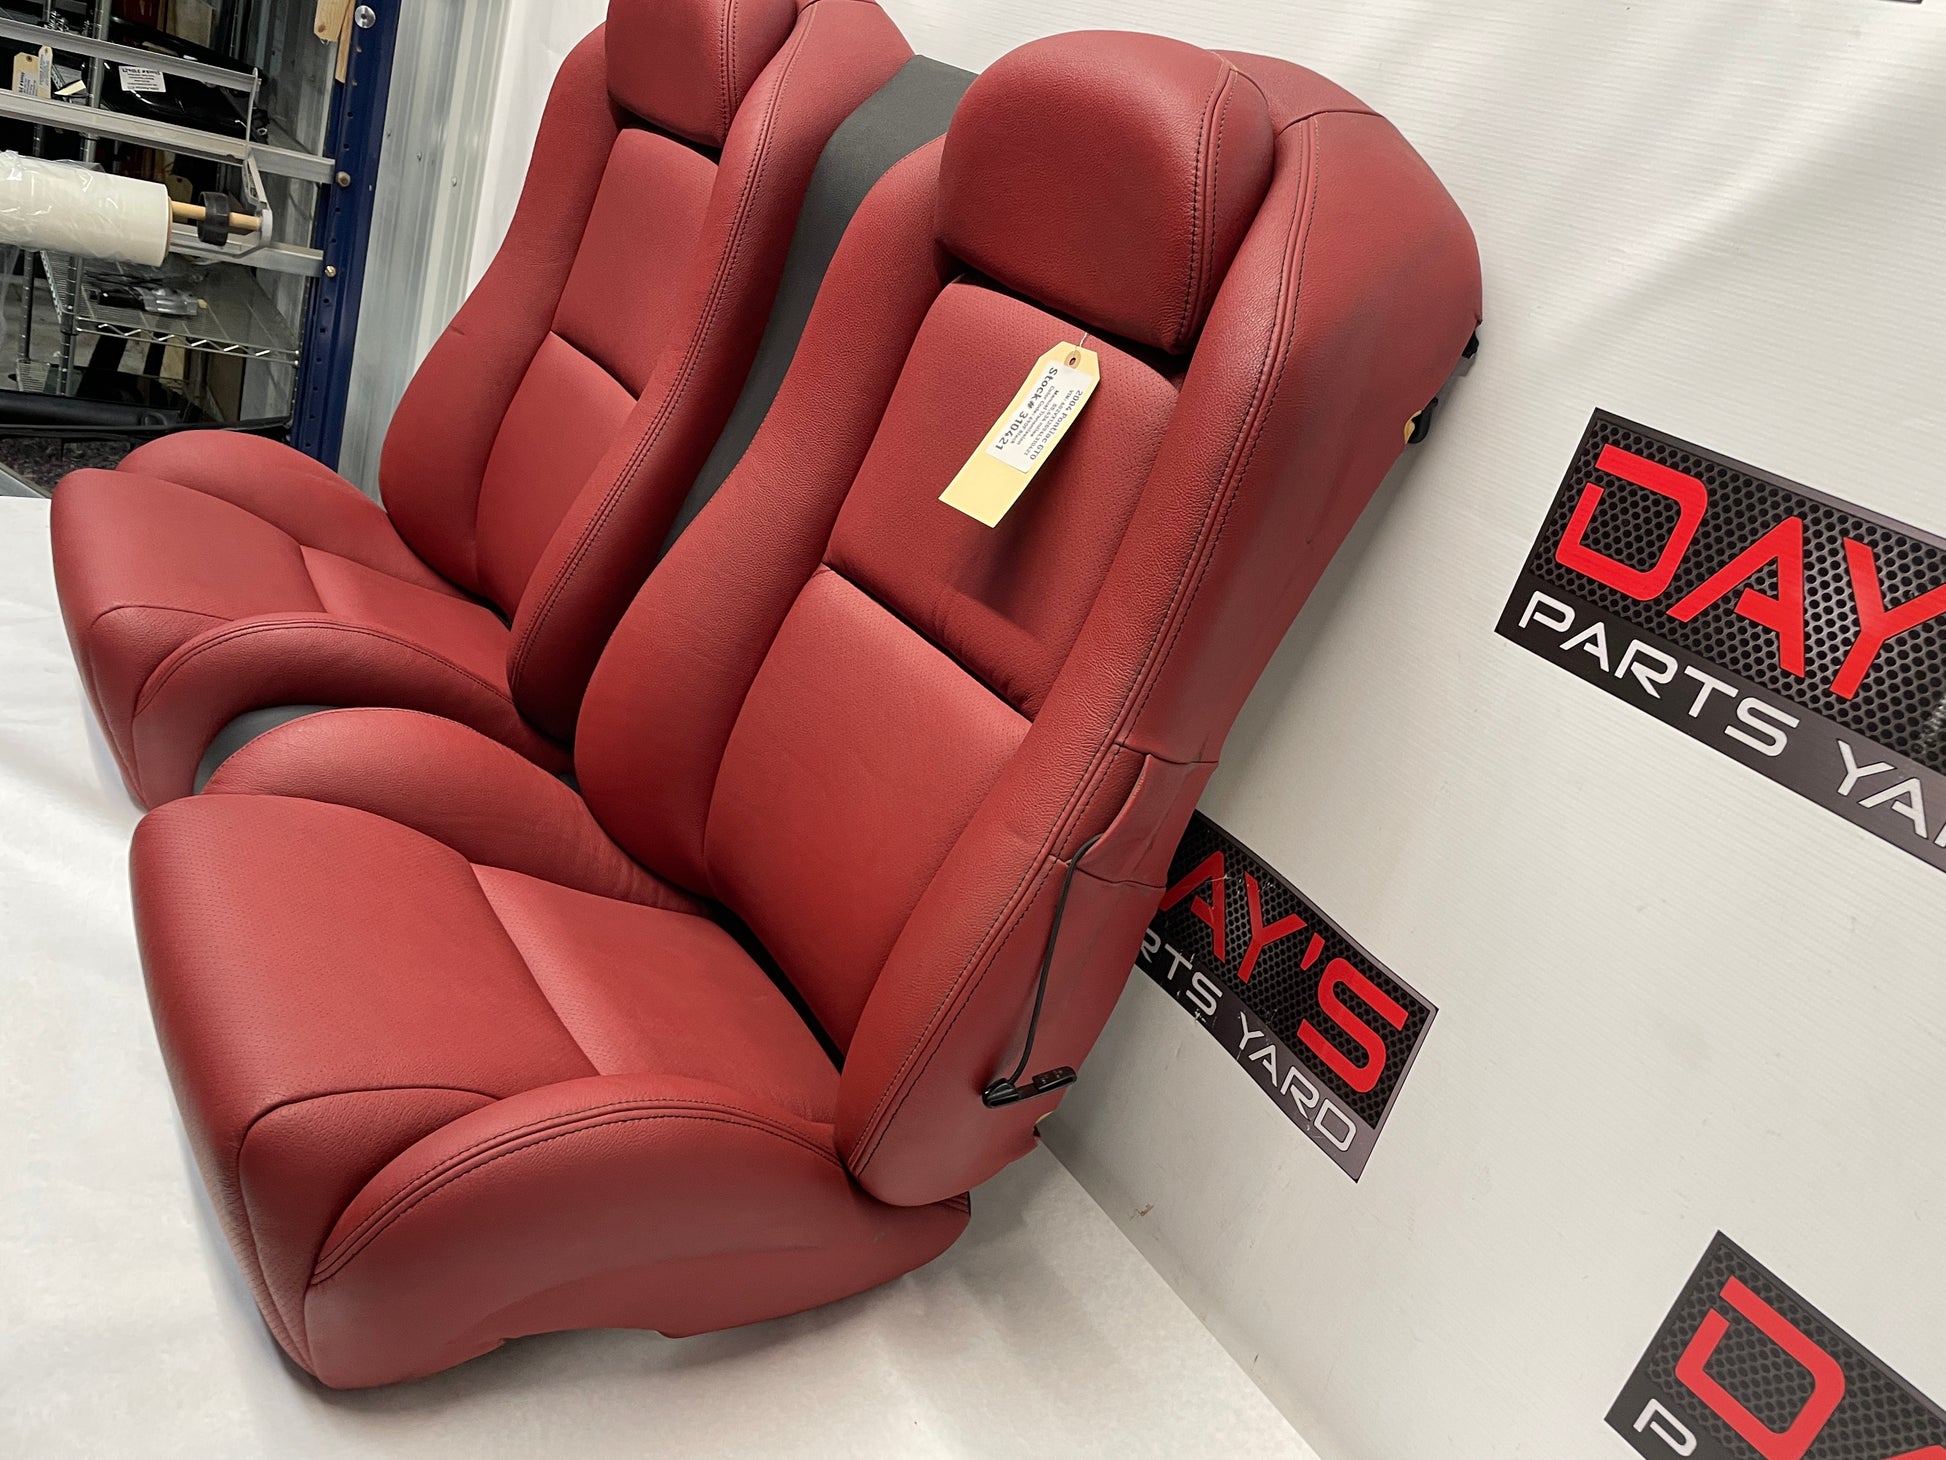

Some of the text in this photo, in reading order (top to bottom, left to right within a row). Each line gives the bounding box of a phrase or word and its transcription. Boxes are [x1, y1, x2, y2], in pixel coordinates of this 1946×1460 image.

[995, 367, 1058, 450] Stock# 310421
[1016, 389, 1059, 445] Manual Transmission
[1029, 389, 1082, 460] 2004 Pontiac GTO
[1031, 400, 1044, 416] Code:
[1042, 385, 1054, 400] Color
[1063, 388, 1073, 401] VIN:
[1030, 422, 1043, 437] miles
[1518, 590, 1946, 848] PARTS YA
[1159, 850, 1408, 1093] AY'S
[1141, 928, 1356, 1151] RTS YARD
[1675, 1275, 1946, 1460] D
